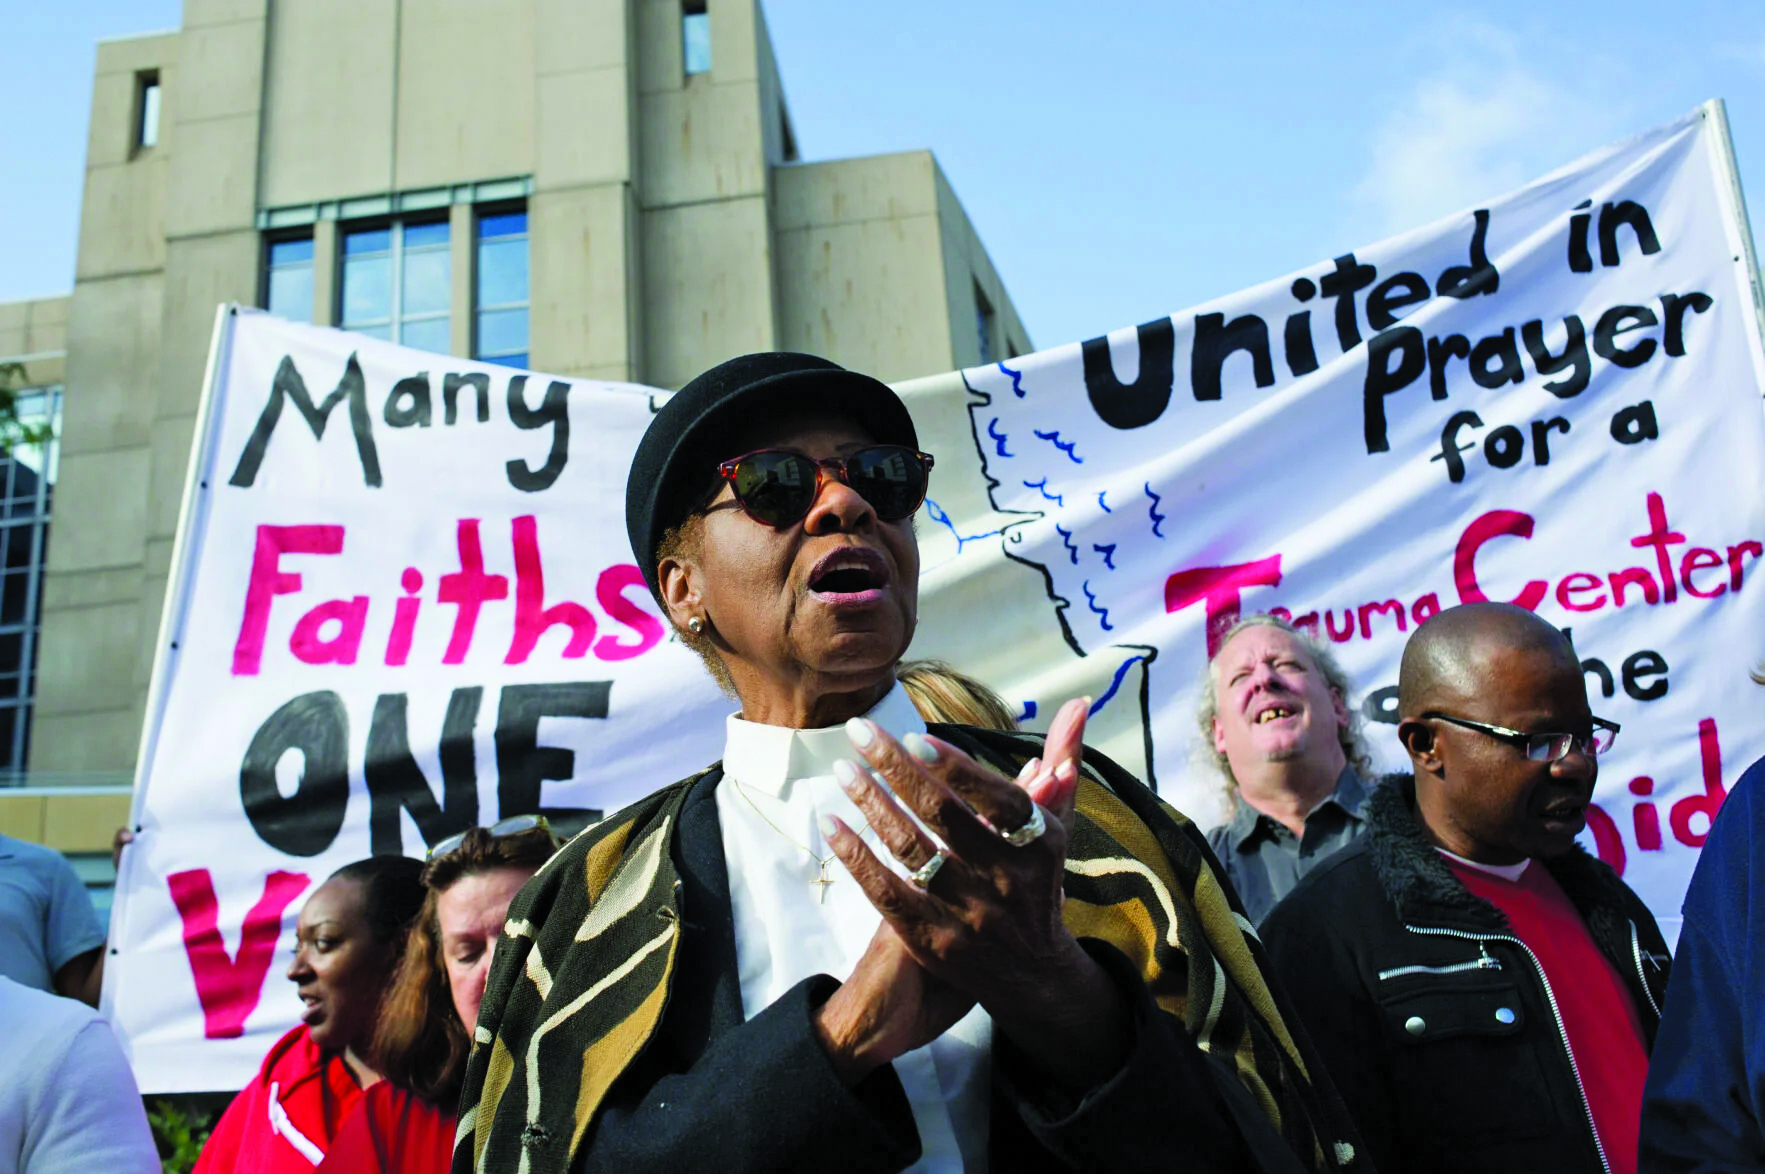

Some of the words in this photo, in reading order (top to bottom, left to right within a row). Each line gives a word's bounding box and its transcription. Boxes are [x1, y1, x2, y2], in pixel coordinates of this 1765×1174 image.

[1081, 209, 1500, 430] United
[1568, 199, 1661, 273] in
[228, 351, 572, 492] Many
[1431, 410, 1571, 483] for
[1610, 400, 1659, 445] a
[232, 515, 665, 676] Faiths
[1453, 491, 1764, 614] Center
[1561, 627, 1669, 701] he
[240, 680, 614, 858] ONE
